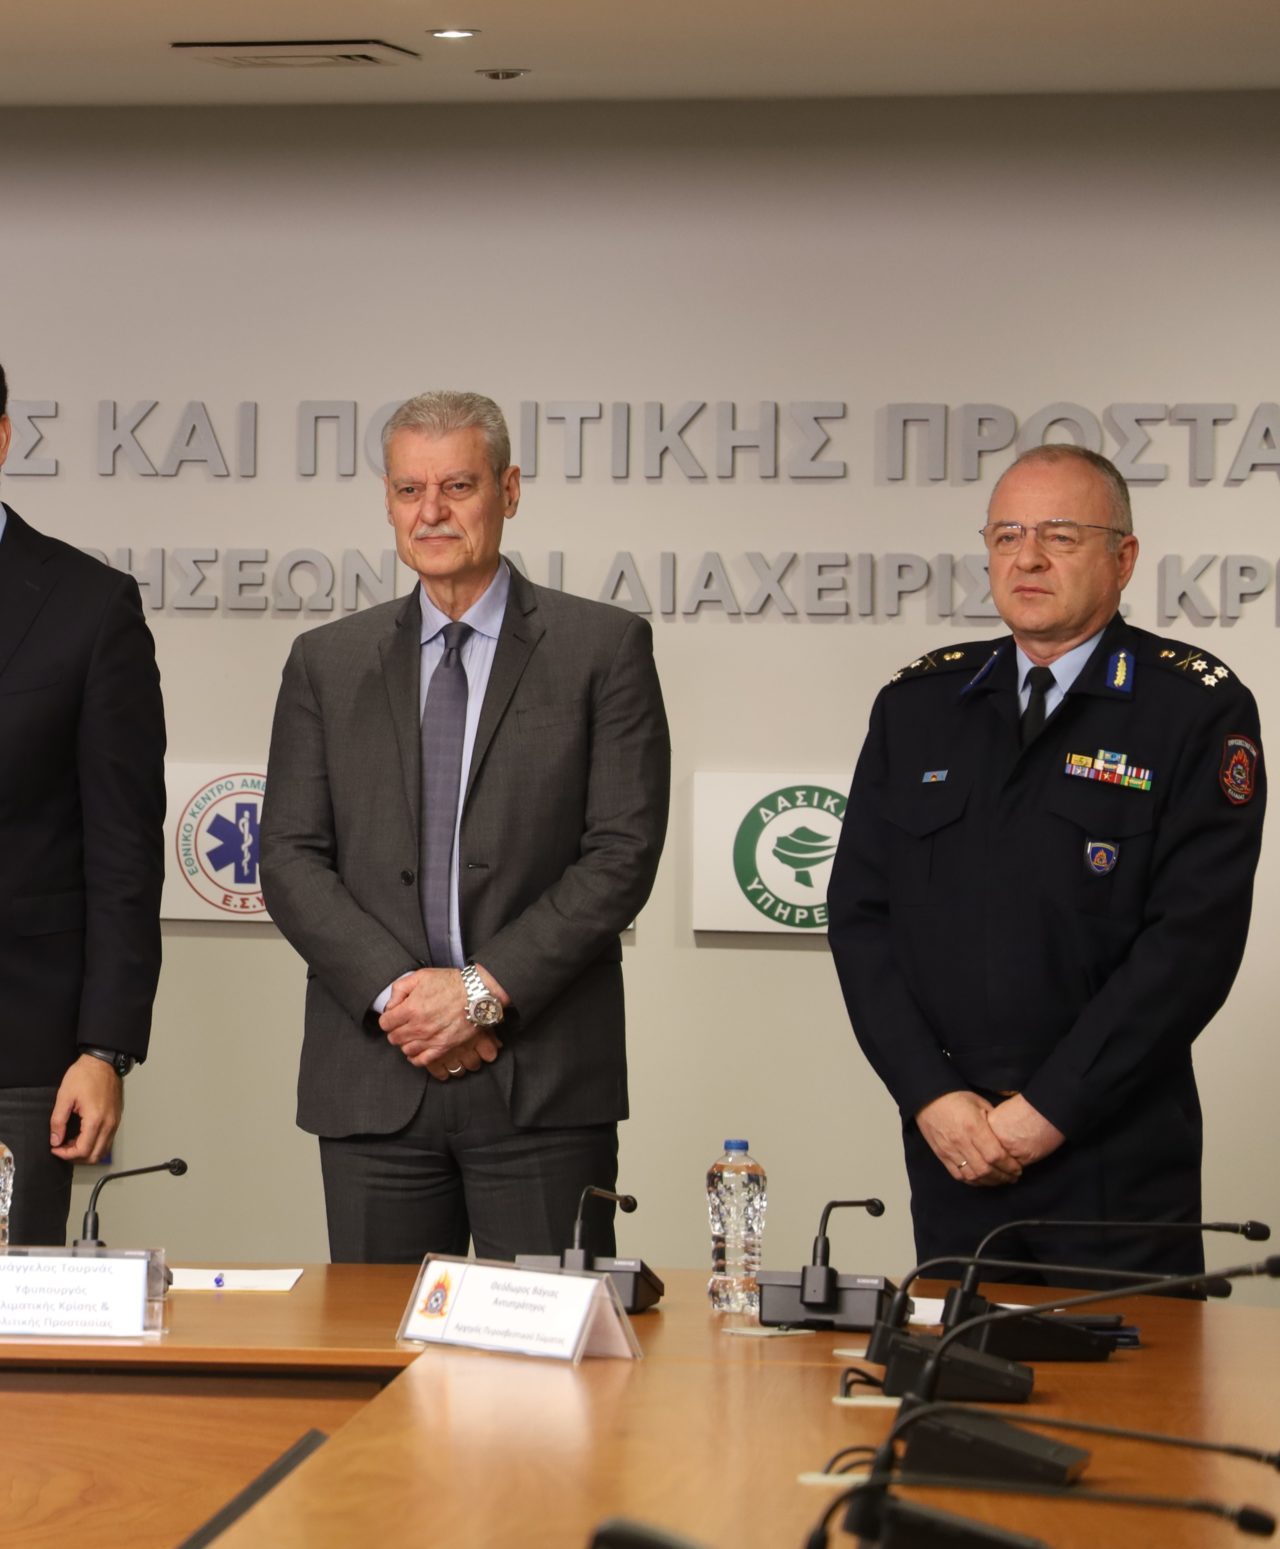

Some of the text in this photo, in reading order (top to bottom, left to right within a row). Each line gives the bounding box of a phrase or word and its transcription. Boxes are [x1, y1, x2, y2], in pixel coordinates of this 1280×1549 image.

[97, 400, 257, 478] ΚΑΙ
[298, 401, 847, 480] ΠΙΤΙΚΗΣ
[1164, 553, 1280, 620] ΚΡ
[189, 780, 235, 820] ΚΕΝΤΡΟ
[181, 822, 199, 876] ΕΘΝΙΚΟ
[58, 1300, 97, 1313] Κρίσης
[100, 1301, 110, 1311] &
